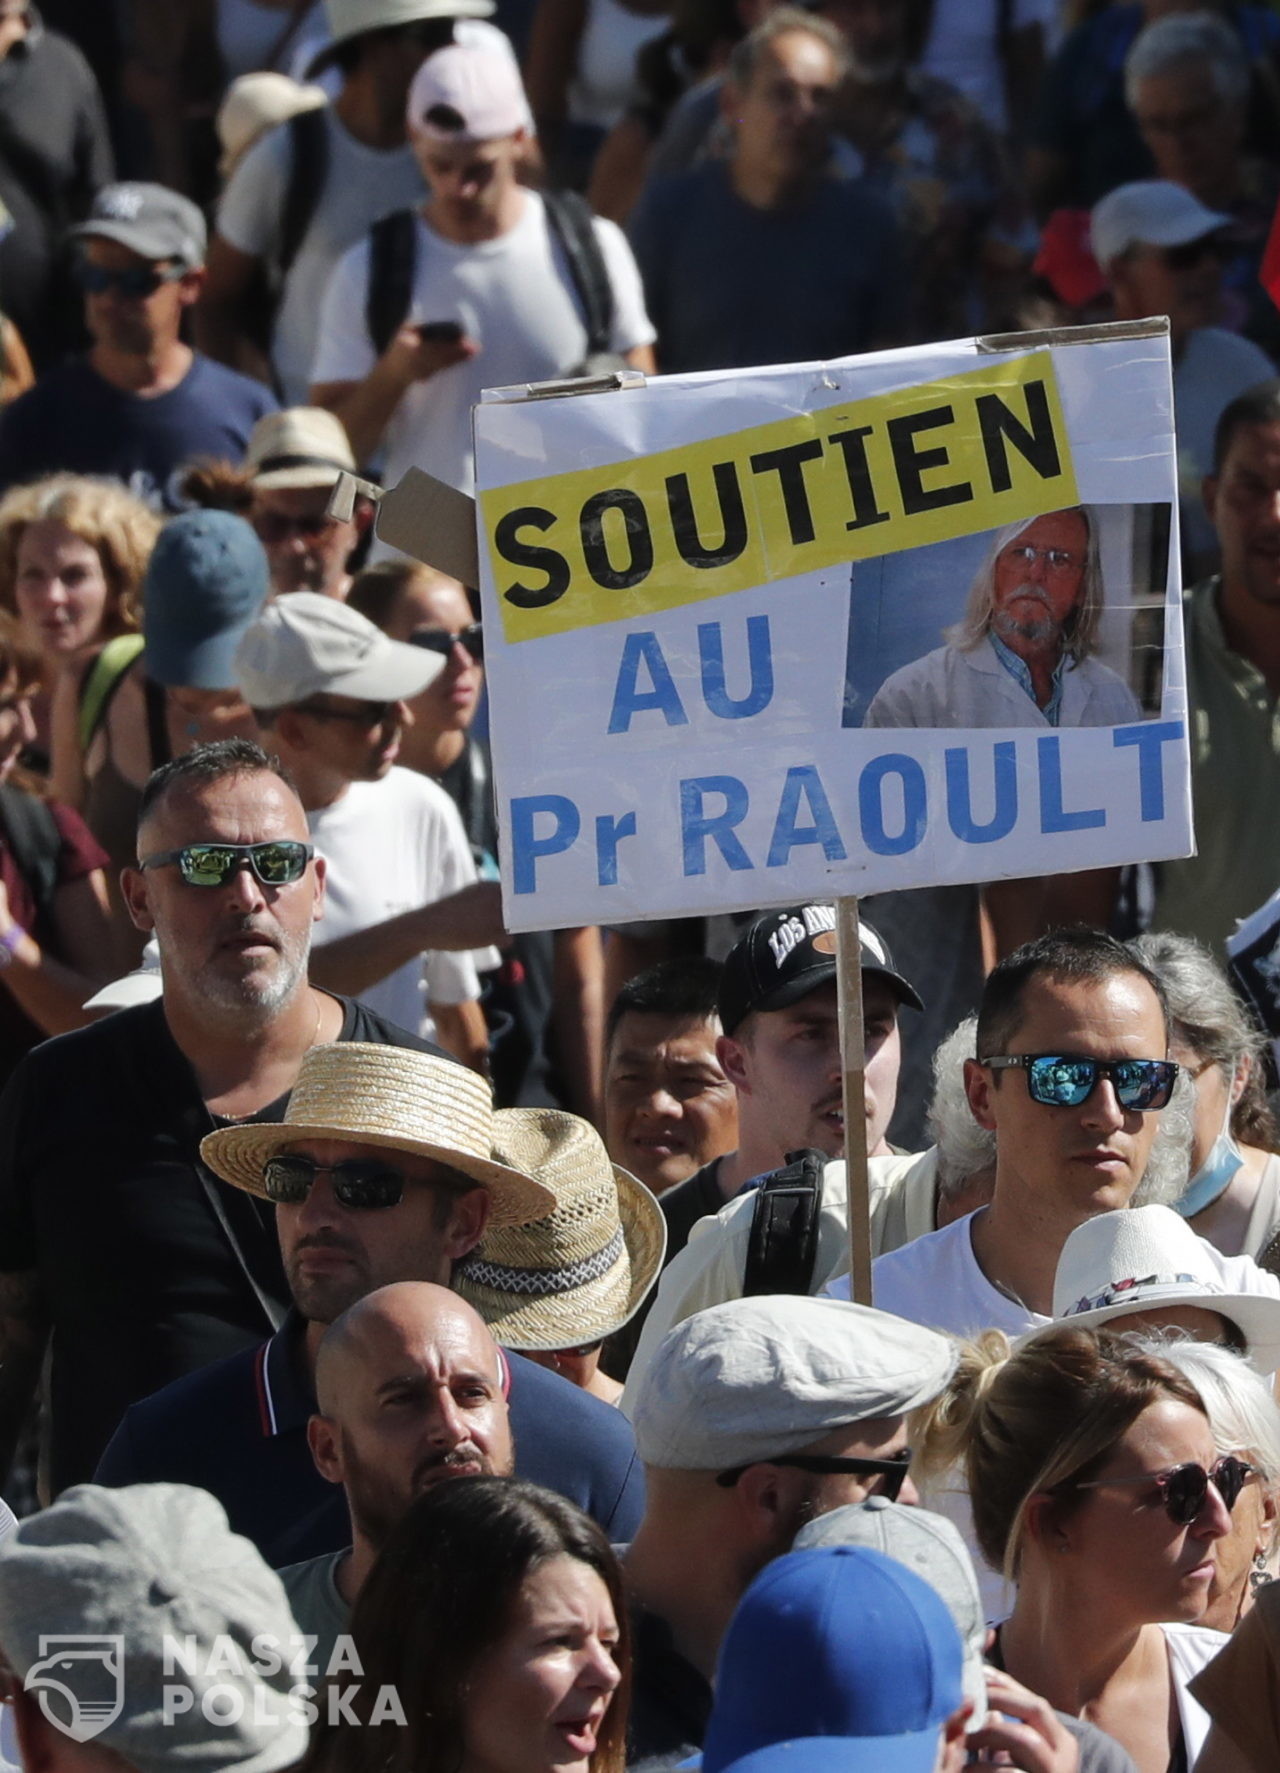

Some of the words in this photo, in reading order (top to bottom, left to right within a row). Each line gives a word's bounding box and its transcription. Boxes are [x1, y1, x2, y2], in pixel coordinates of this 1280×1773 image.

[494, 379, 1063, 609] SOUTIEN
[607, 614, 776, 735] AU
[509, 794, 637, 895] Pr
[679, 720, 1185, 878] RAOULT
[768, 916, 807, 970] LOS
